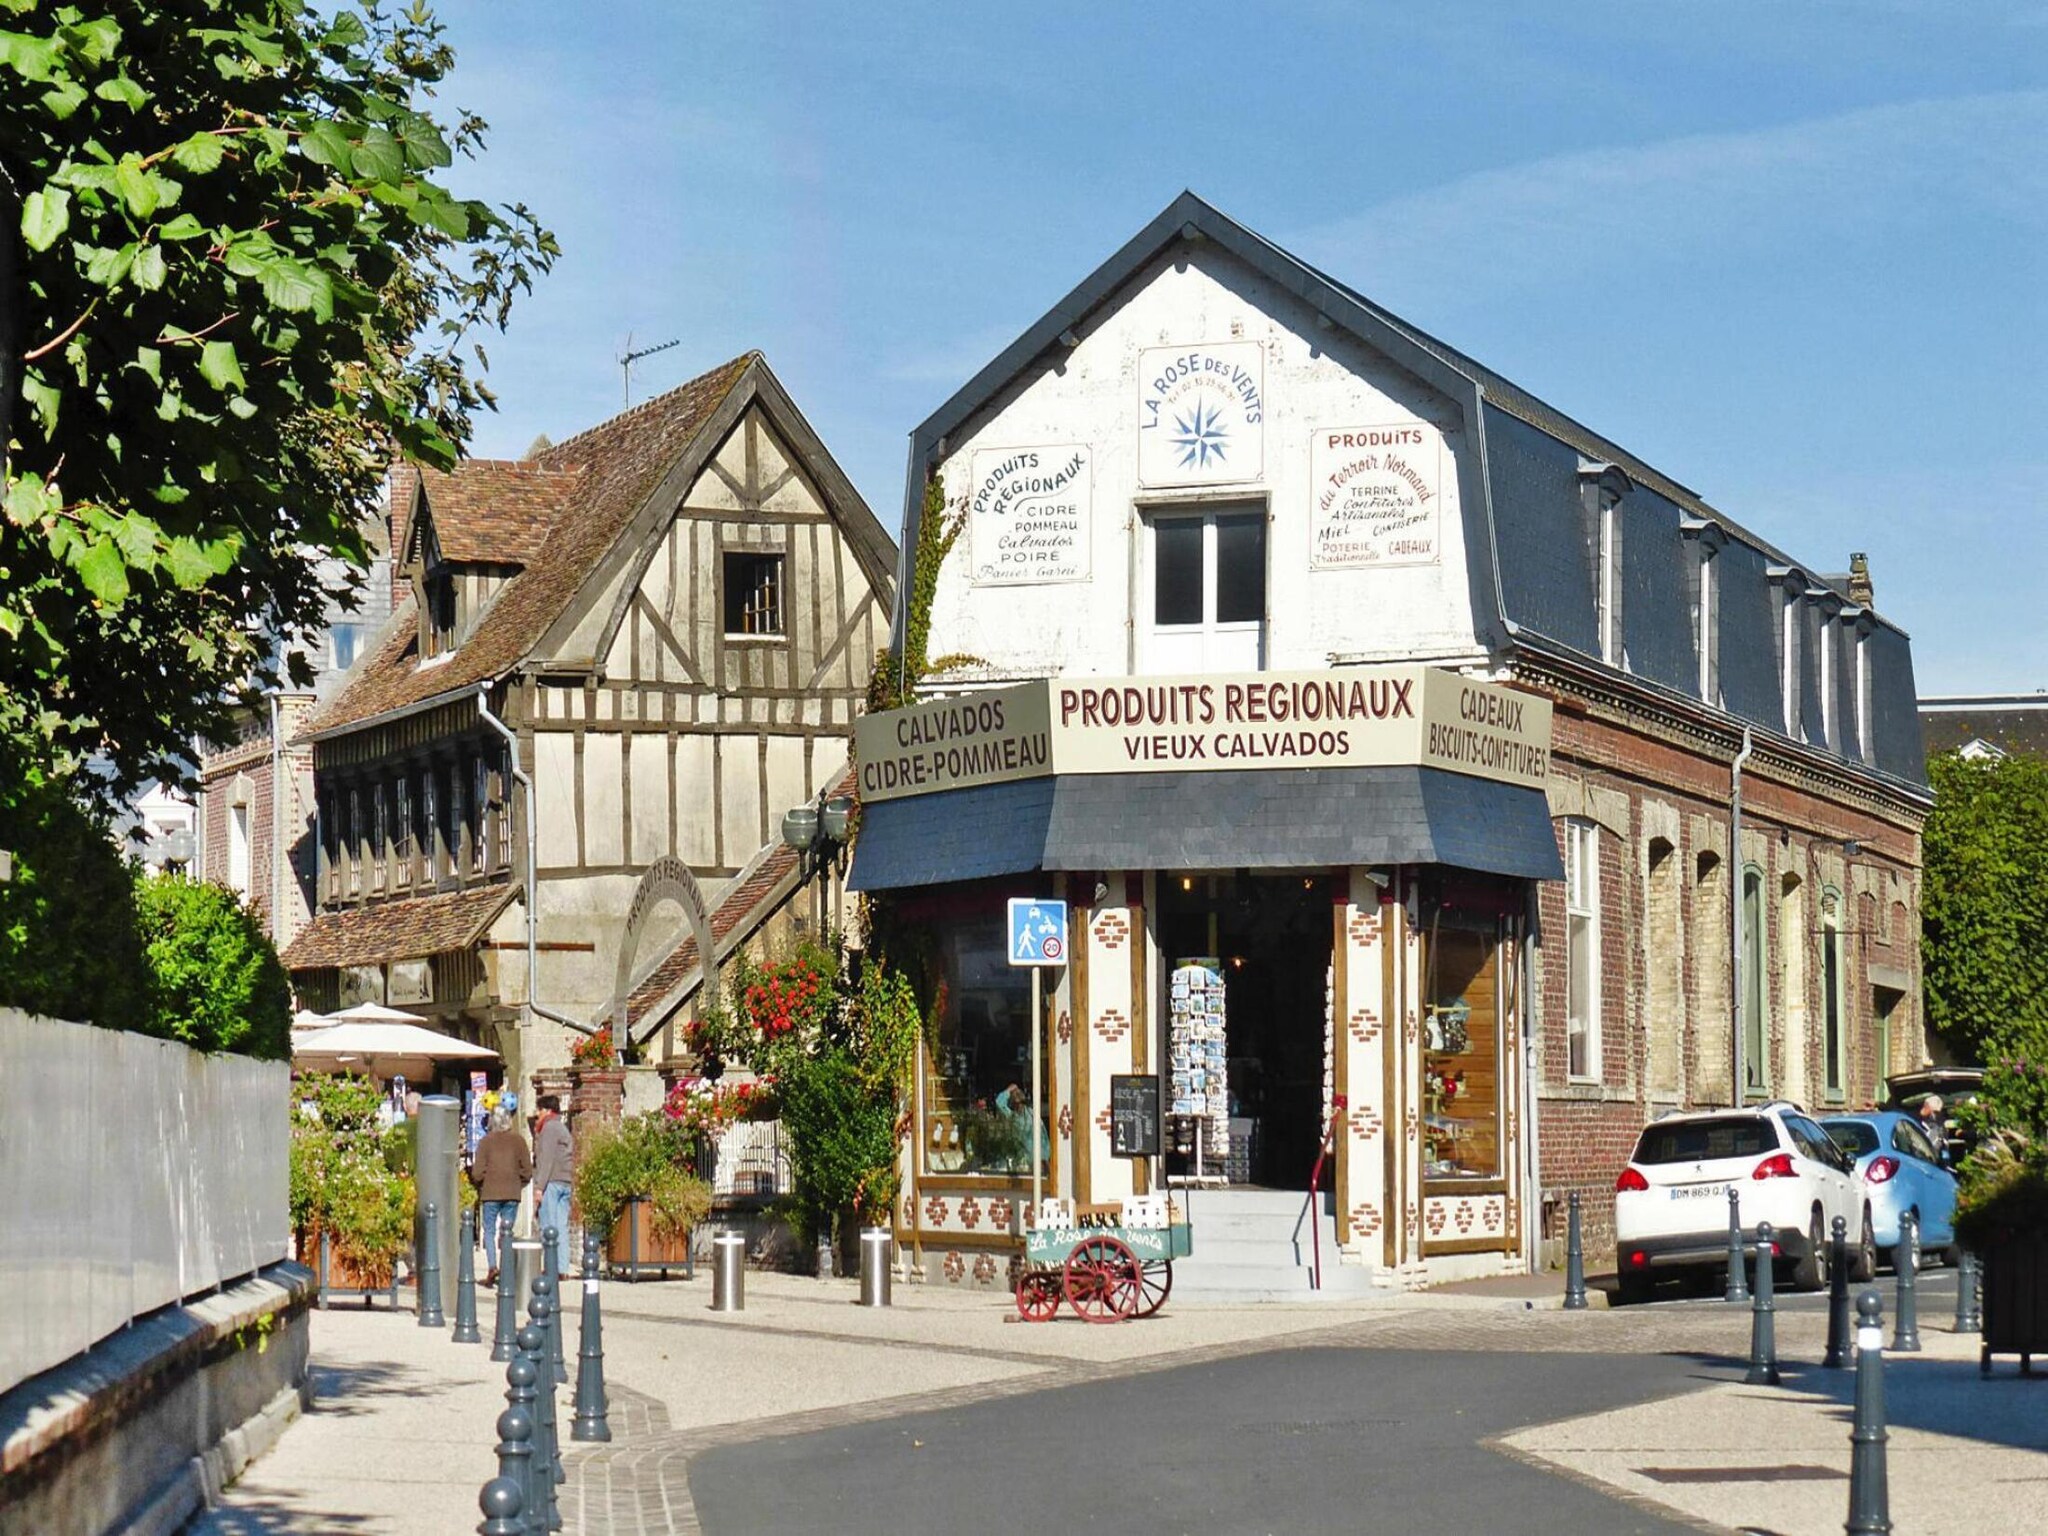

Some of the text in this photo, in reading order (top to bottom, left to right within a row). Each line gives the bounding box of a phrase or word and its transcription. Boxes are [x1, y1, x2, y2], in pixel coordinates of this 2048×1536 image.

[1142, 399, 1161, 429] LA
[1154, 354, 1200, 394] ROSE
[1205, 358, 1231, 376] DES
[1231, 365, 1262, 424] VENTS
[1329, 454, 1379, 489] Terroir
[1383, 453, 1437, 505] Normand
[1351, 485, 1400, 498] TERRINE
[1015, 520, 1078, 532] POMMEAU
[1027, 505, 1078, 518] CIDRE
[998, 535, 1073, 549] Calvados
[1322, 542, 1371, 554] POTERIE
[1388, 540, 1433, 556] CADEAUX
[1061, 678, 1416, 728] PRODUITS REGIONAUX
[1459, 687, 1523, 734] CADEAUX
[897, 699, 1006, 749] CALVADOS
[1124, 730, 1350, 761] VIEUX CALVADOS
[1428, 722, 1547, 779] BISCUITS-CONFITURES
[863, 732, 1048, 792] CIDRE-POMMEAU
[627, 862, 662, 937] PRODUITS
[1046, 942, 1058, 953] 20
[1030, 1231, 1047, 1252] La
[1052, 1230, 1091, 1246] Rose
